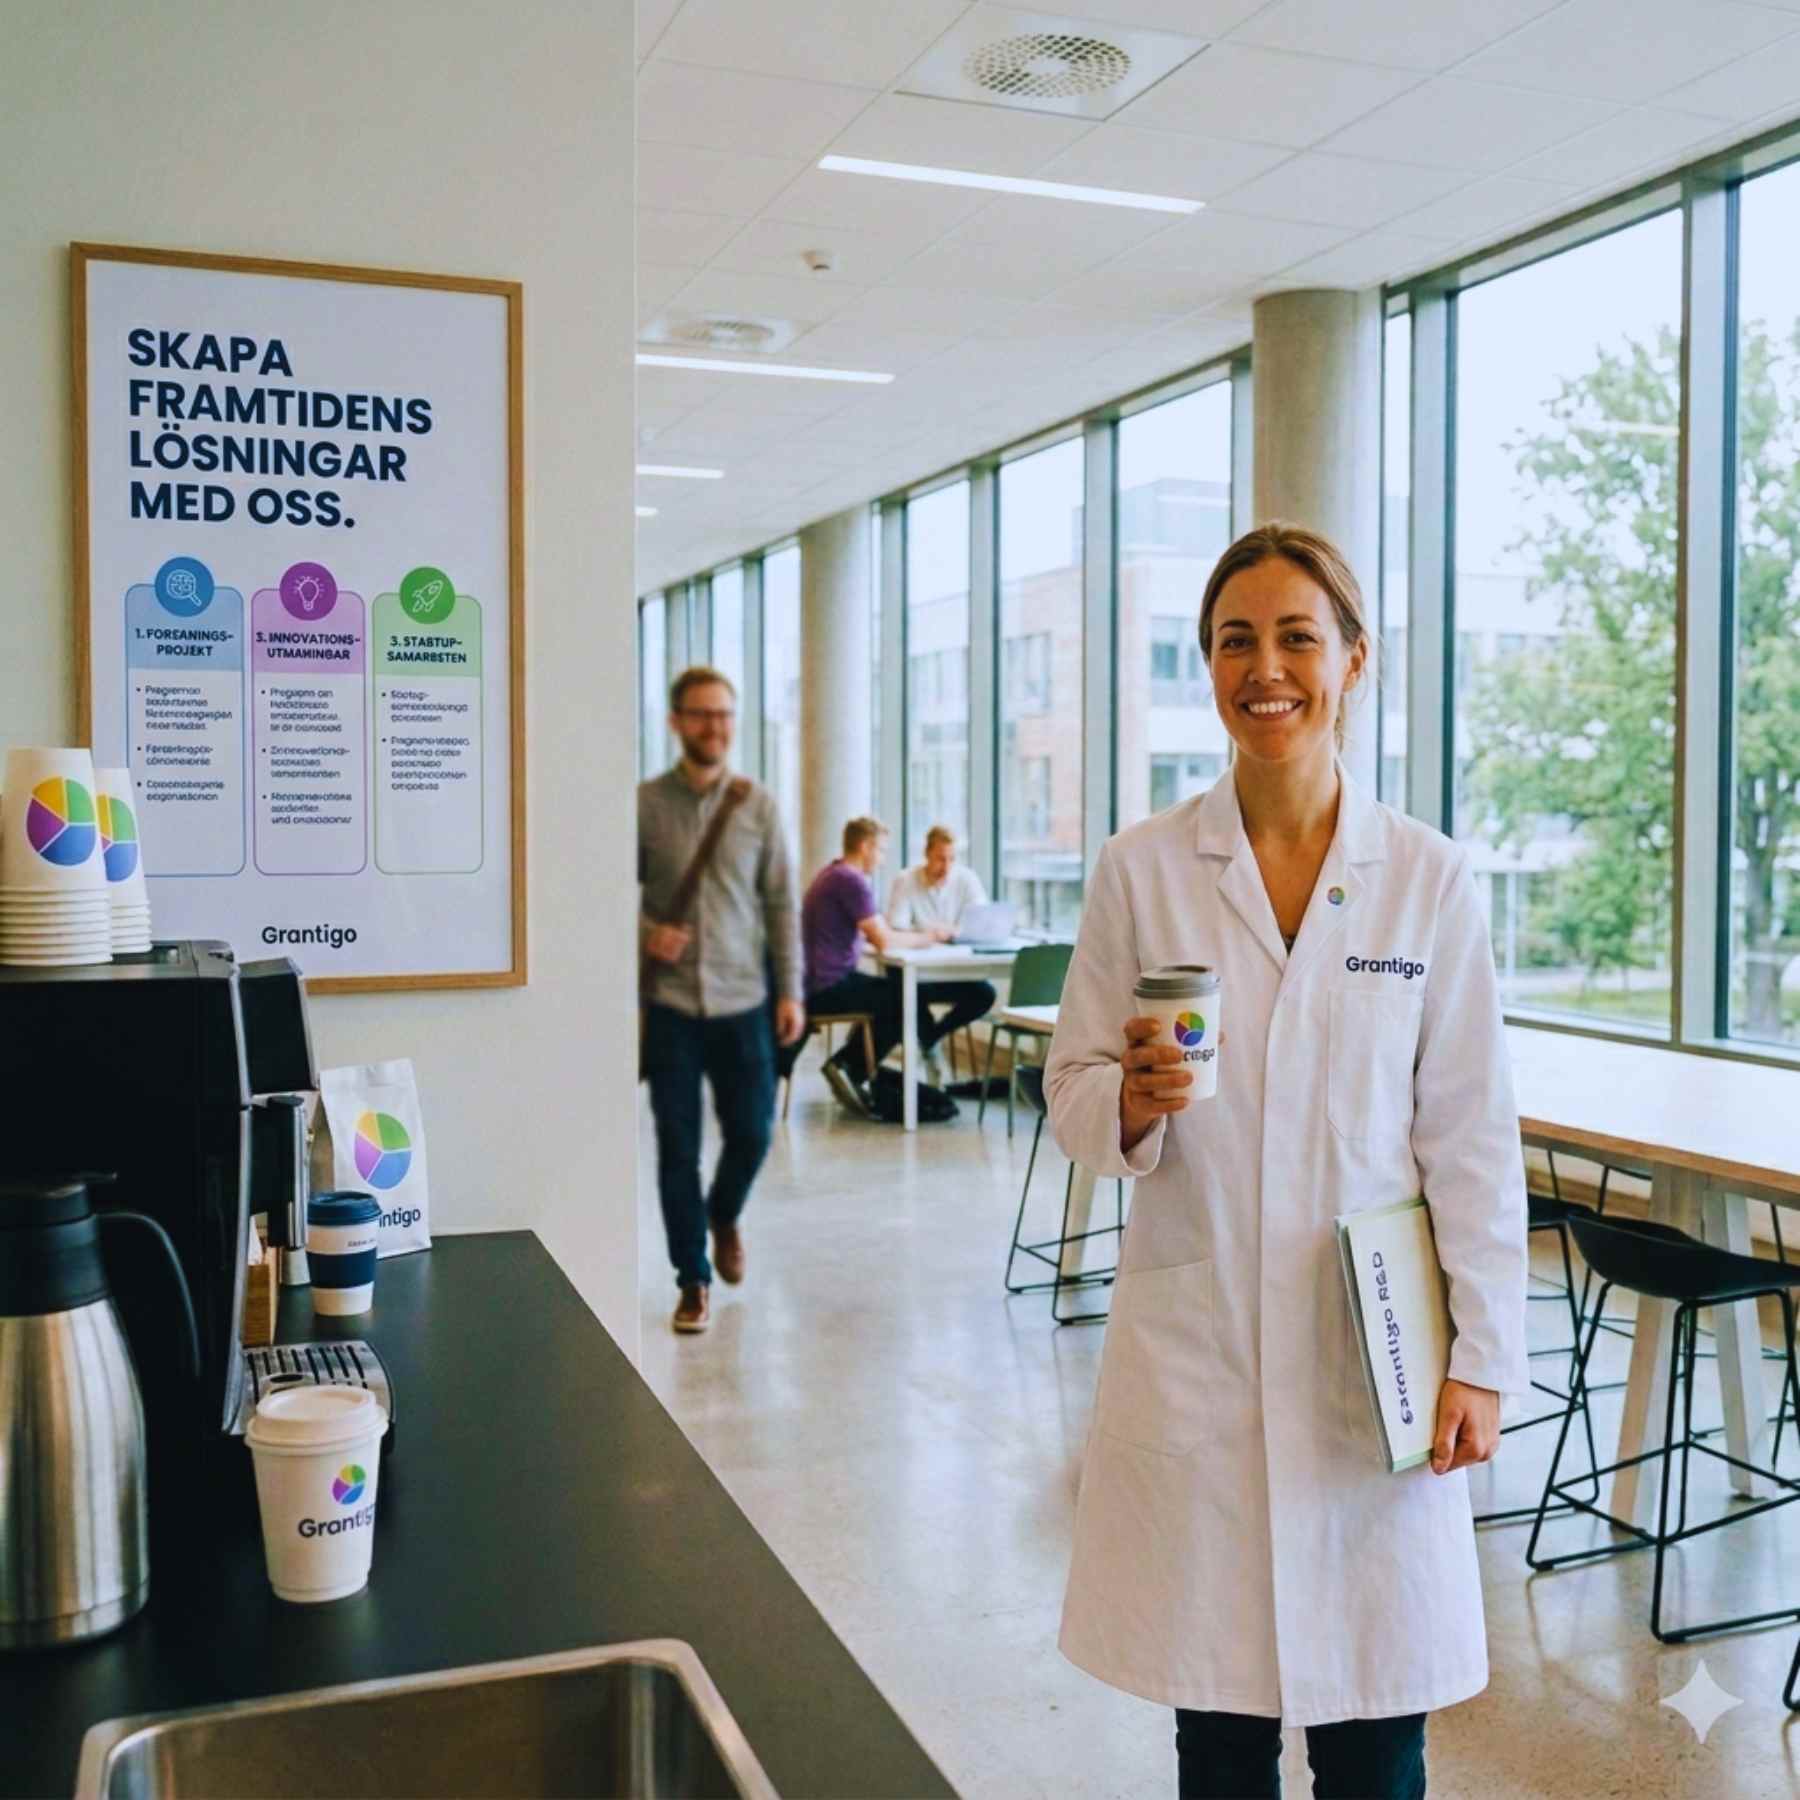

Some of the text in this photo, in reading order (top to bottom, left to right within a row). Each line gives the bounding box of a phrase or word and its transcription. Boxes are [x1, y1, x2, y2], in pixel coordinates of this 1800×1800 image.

[128, 328, 294, 377] SKAPA
[129, 379, 433, 435] FRAMTIDENS
[130, 423, 407, 482] LÖSNINGAR
[130, 481, 355, 528] MED OSS.
[135, 628, 145, 639] 1.
[269, 632, 361, 645] INNOVATIONS-
[389, 636, 401, 647] 3.
[261, 924, 357, 949] Grantigo
[1346, 956, 1425, 980] Grantigo
